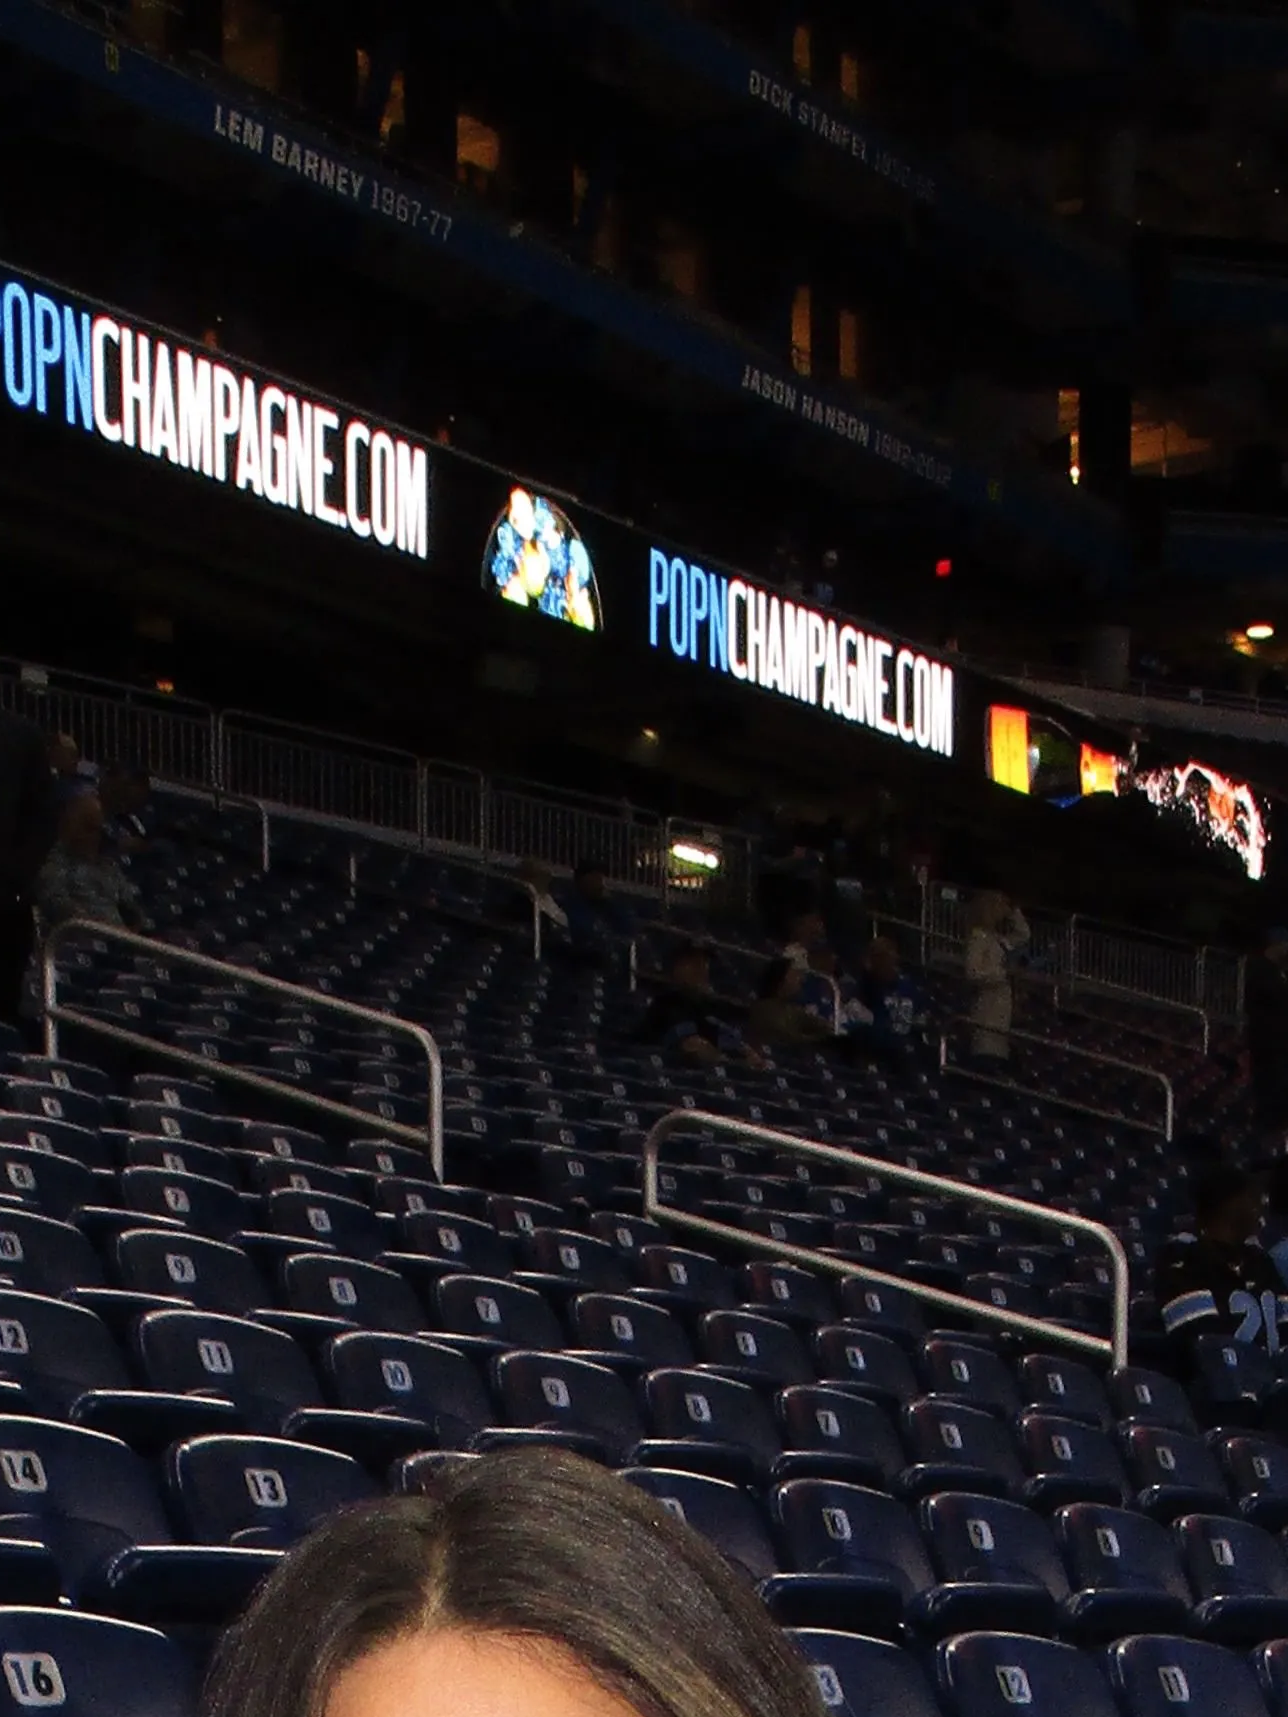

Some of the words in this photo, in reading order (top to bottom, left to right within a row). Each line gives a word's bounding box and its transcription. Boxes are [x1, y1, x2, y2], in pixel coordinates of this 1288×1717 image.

[749, 69, 795, 119] DICK
[213, 104, 264, 155] LEM
[271, 133, 364, 201] BARNEY
[369, 180, 454, 243] 1967-77
[741, 364, 797, 413] JASON
[801, 393, 870, 449] HANSON
[649, 547, 954, 758] POPNCHAMPAGNE.COM
[204, 1345, 227, 1368] 11
[386, 1364, 406, 1386] 10
[5, 1456, 39, 1485] 14
[250, 1474, 280, 1501] 13
[826, 1512, 844, 1536] 10
[10, 1660, 54, 1697] 16
[1001, 1671, 1024, 1698] 12
[1163, 1671, 1183, 1698] 11
